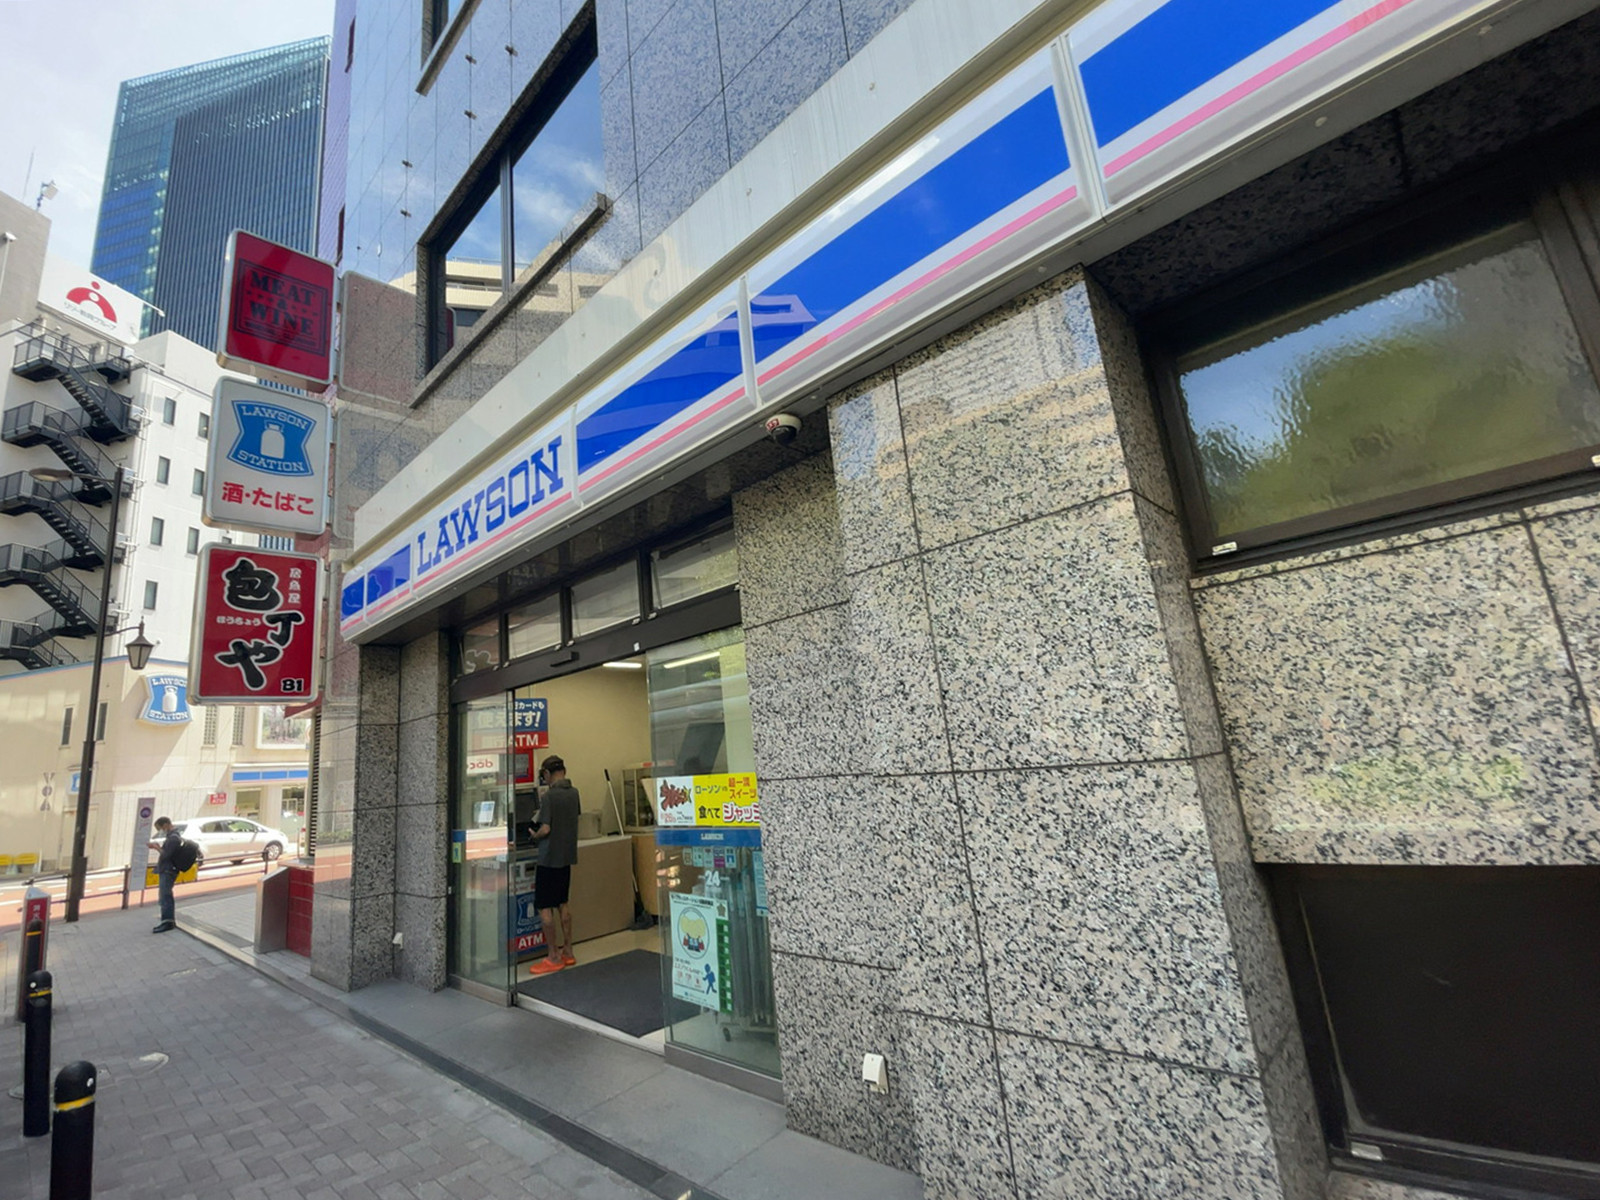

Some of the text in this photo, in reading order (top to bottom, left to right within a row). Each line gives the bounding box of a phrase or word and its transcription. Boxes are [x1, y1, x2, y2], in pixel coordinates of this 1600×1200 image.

[250, 270, 316, 306] MEAT
[249, 301, 314, 335] WINE
[241, 405, 309, 430] LAWSON
[237, 450, 305, 472] STATION
[418, 435, 563, 576] LAWSON
[151, 677, 187, 687] LAWSO
[281, 678, 304, 692] B1
[704, 870, 720, 887] 24
[518, 933, 543, 949] ATM
